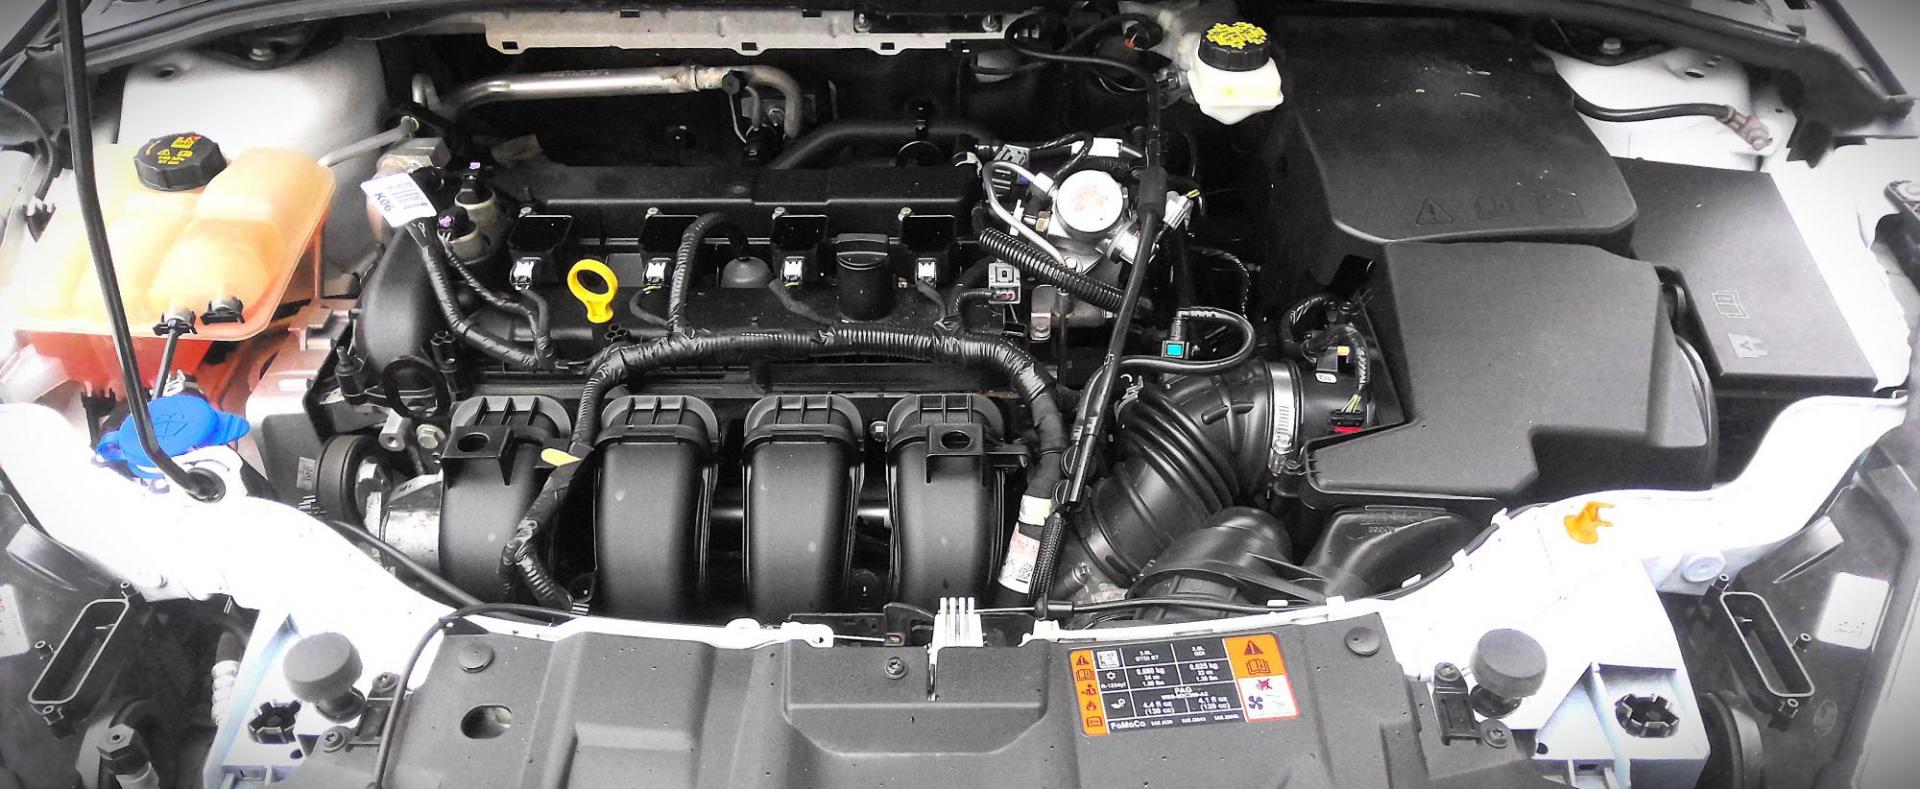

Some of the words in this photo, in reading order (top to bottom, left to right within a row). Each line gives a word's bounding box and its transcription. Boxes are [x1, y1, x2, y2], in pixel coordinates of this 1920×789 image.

[1208, 662, 1219, 670] kg
[1155, 667, 1165, 675] kg
[1110, 720, 1146, 730] FoMoCo
